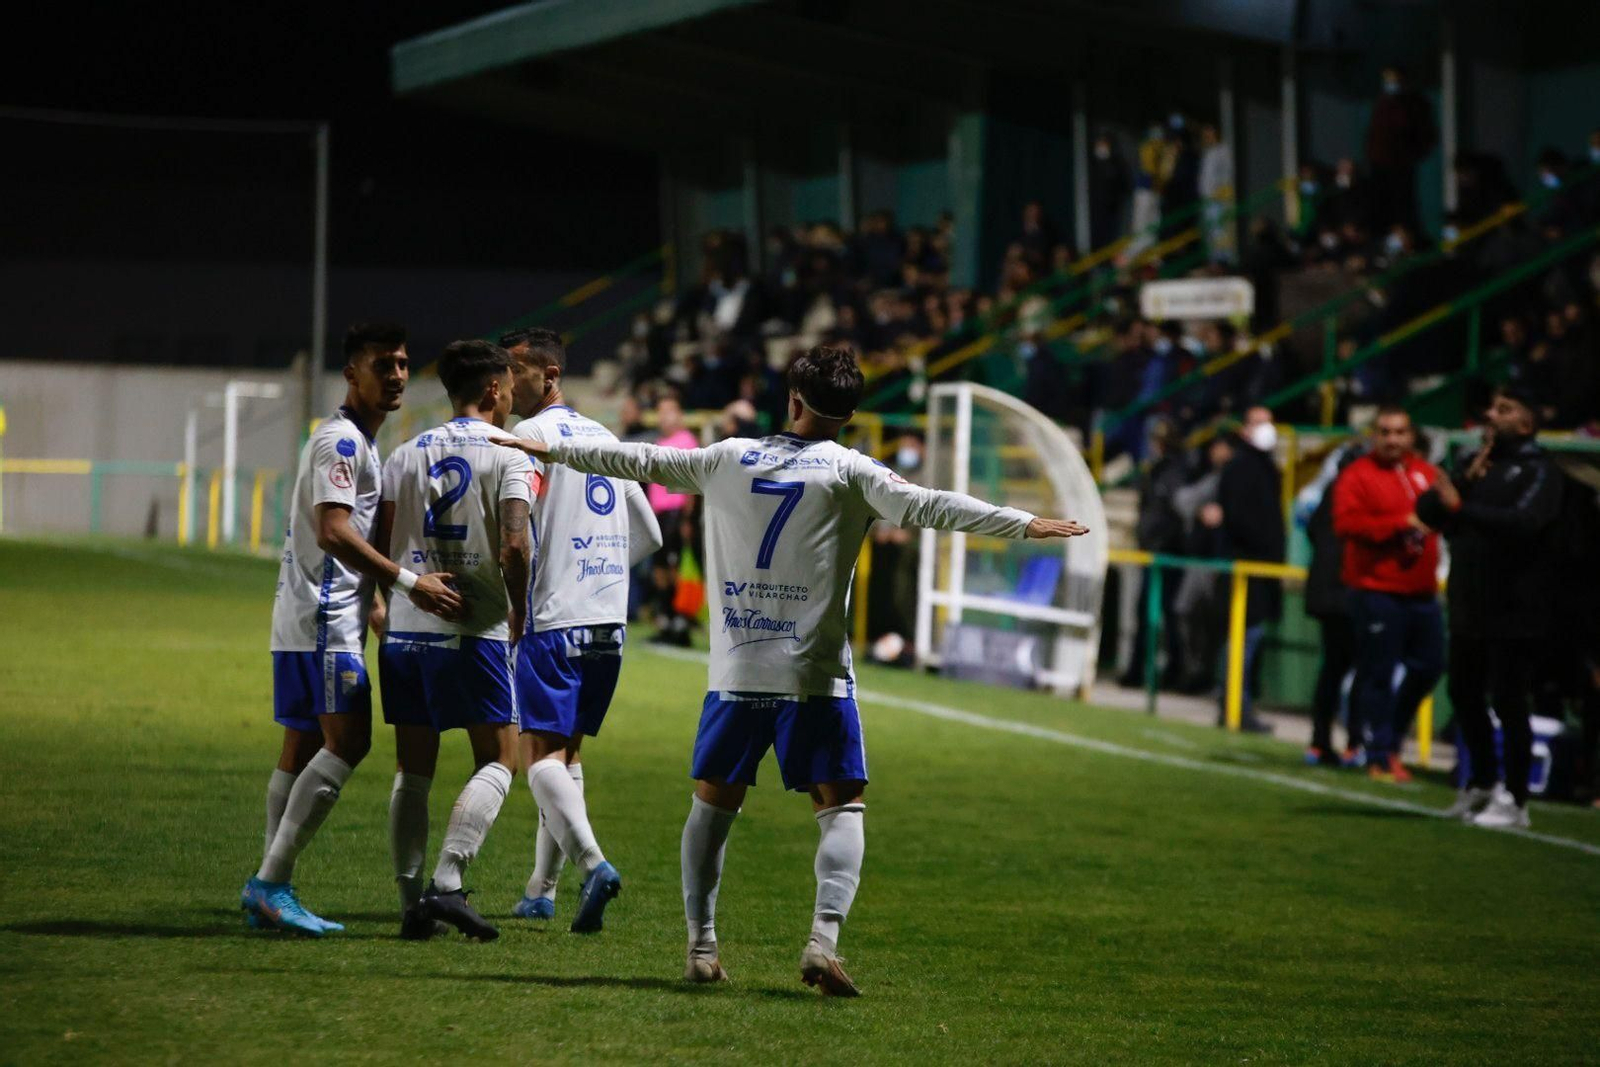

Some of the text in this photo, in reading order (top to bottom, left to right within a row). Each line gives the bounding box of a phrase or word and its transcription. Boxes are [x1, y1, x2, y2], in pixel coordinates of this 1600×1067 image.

[424, 456, 472, 541] 2
[585, 474, 616, 516] 6
[751, 478, 806, 570] 7
[749, 583, 809, 594] ARQUITECTO
[749, 591, 808, 602] VILARCHAO
